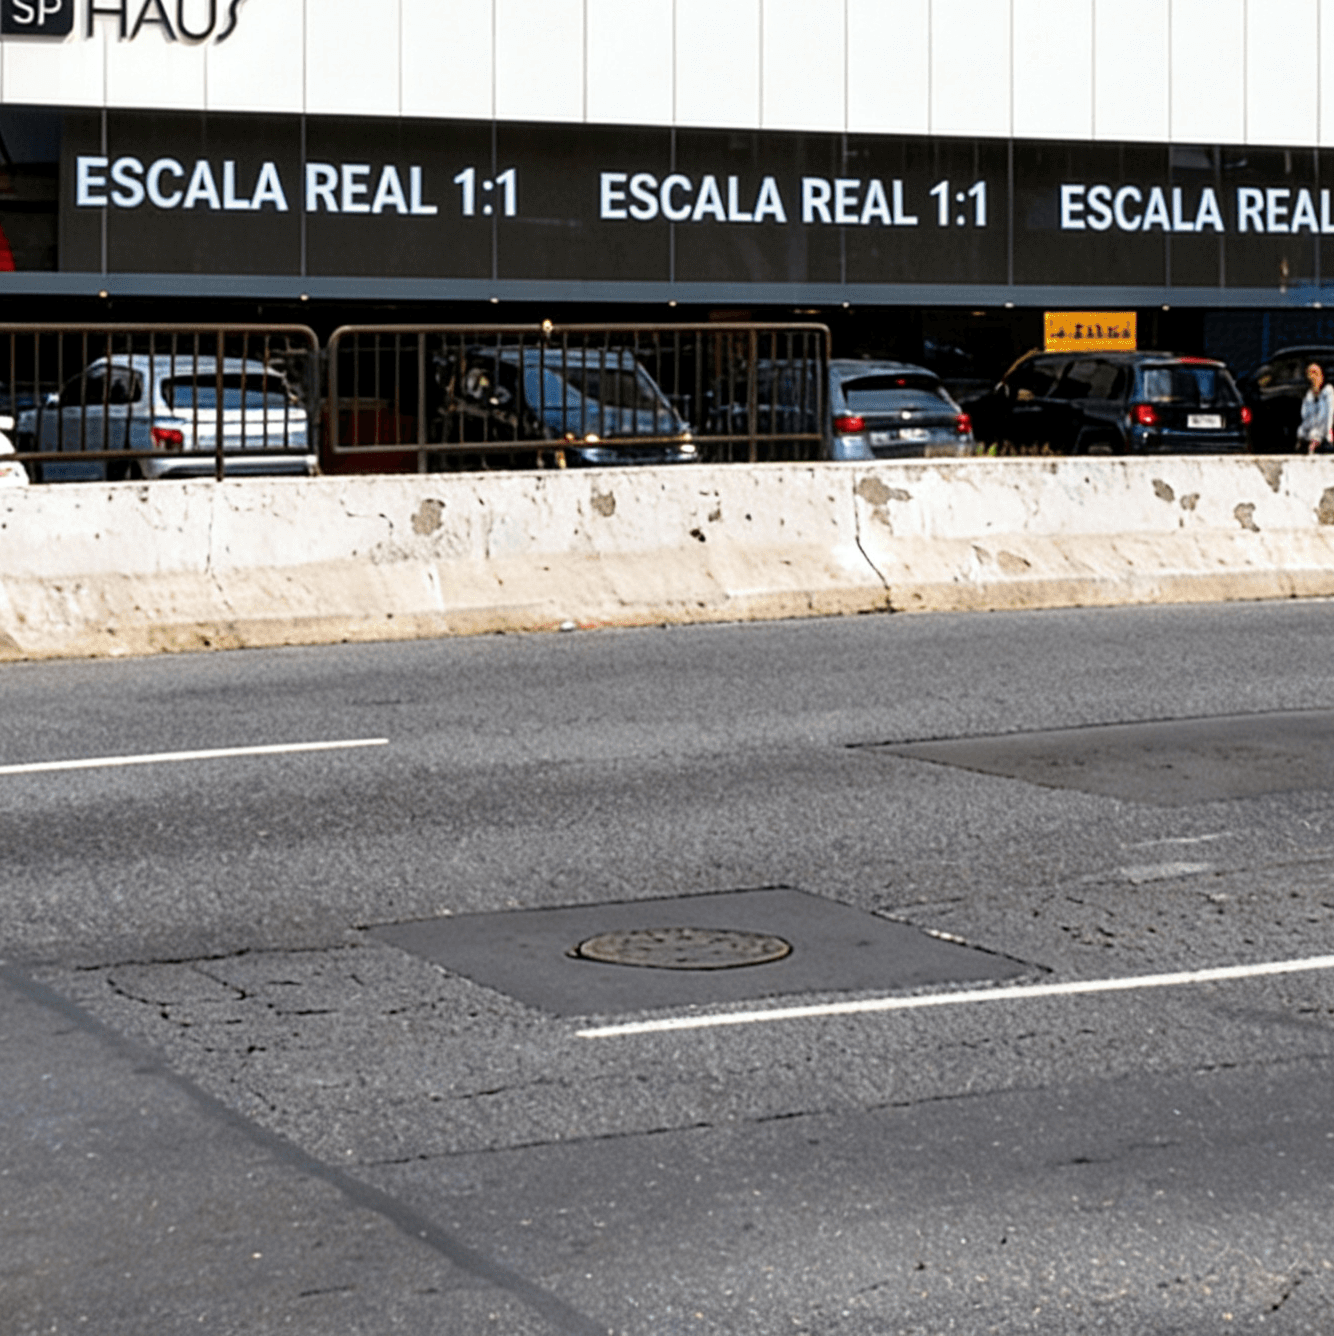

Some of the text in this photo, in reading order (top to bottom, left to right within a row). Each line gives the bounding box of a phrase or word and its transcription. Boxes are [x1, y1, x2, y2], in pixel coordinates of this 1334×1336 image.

[76, 156, 516, 216] ESCALA REAL 1:1
[600, 172, 987, 226] ESCALA REAL 1:1
[1060, 185, 1225, 231] ESCALA
